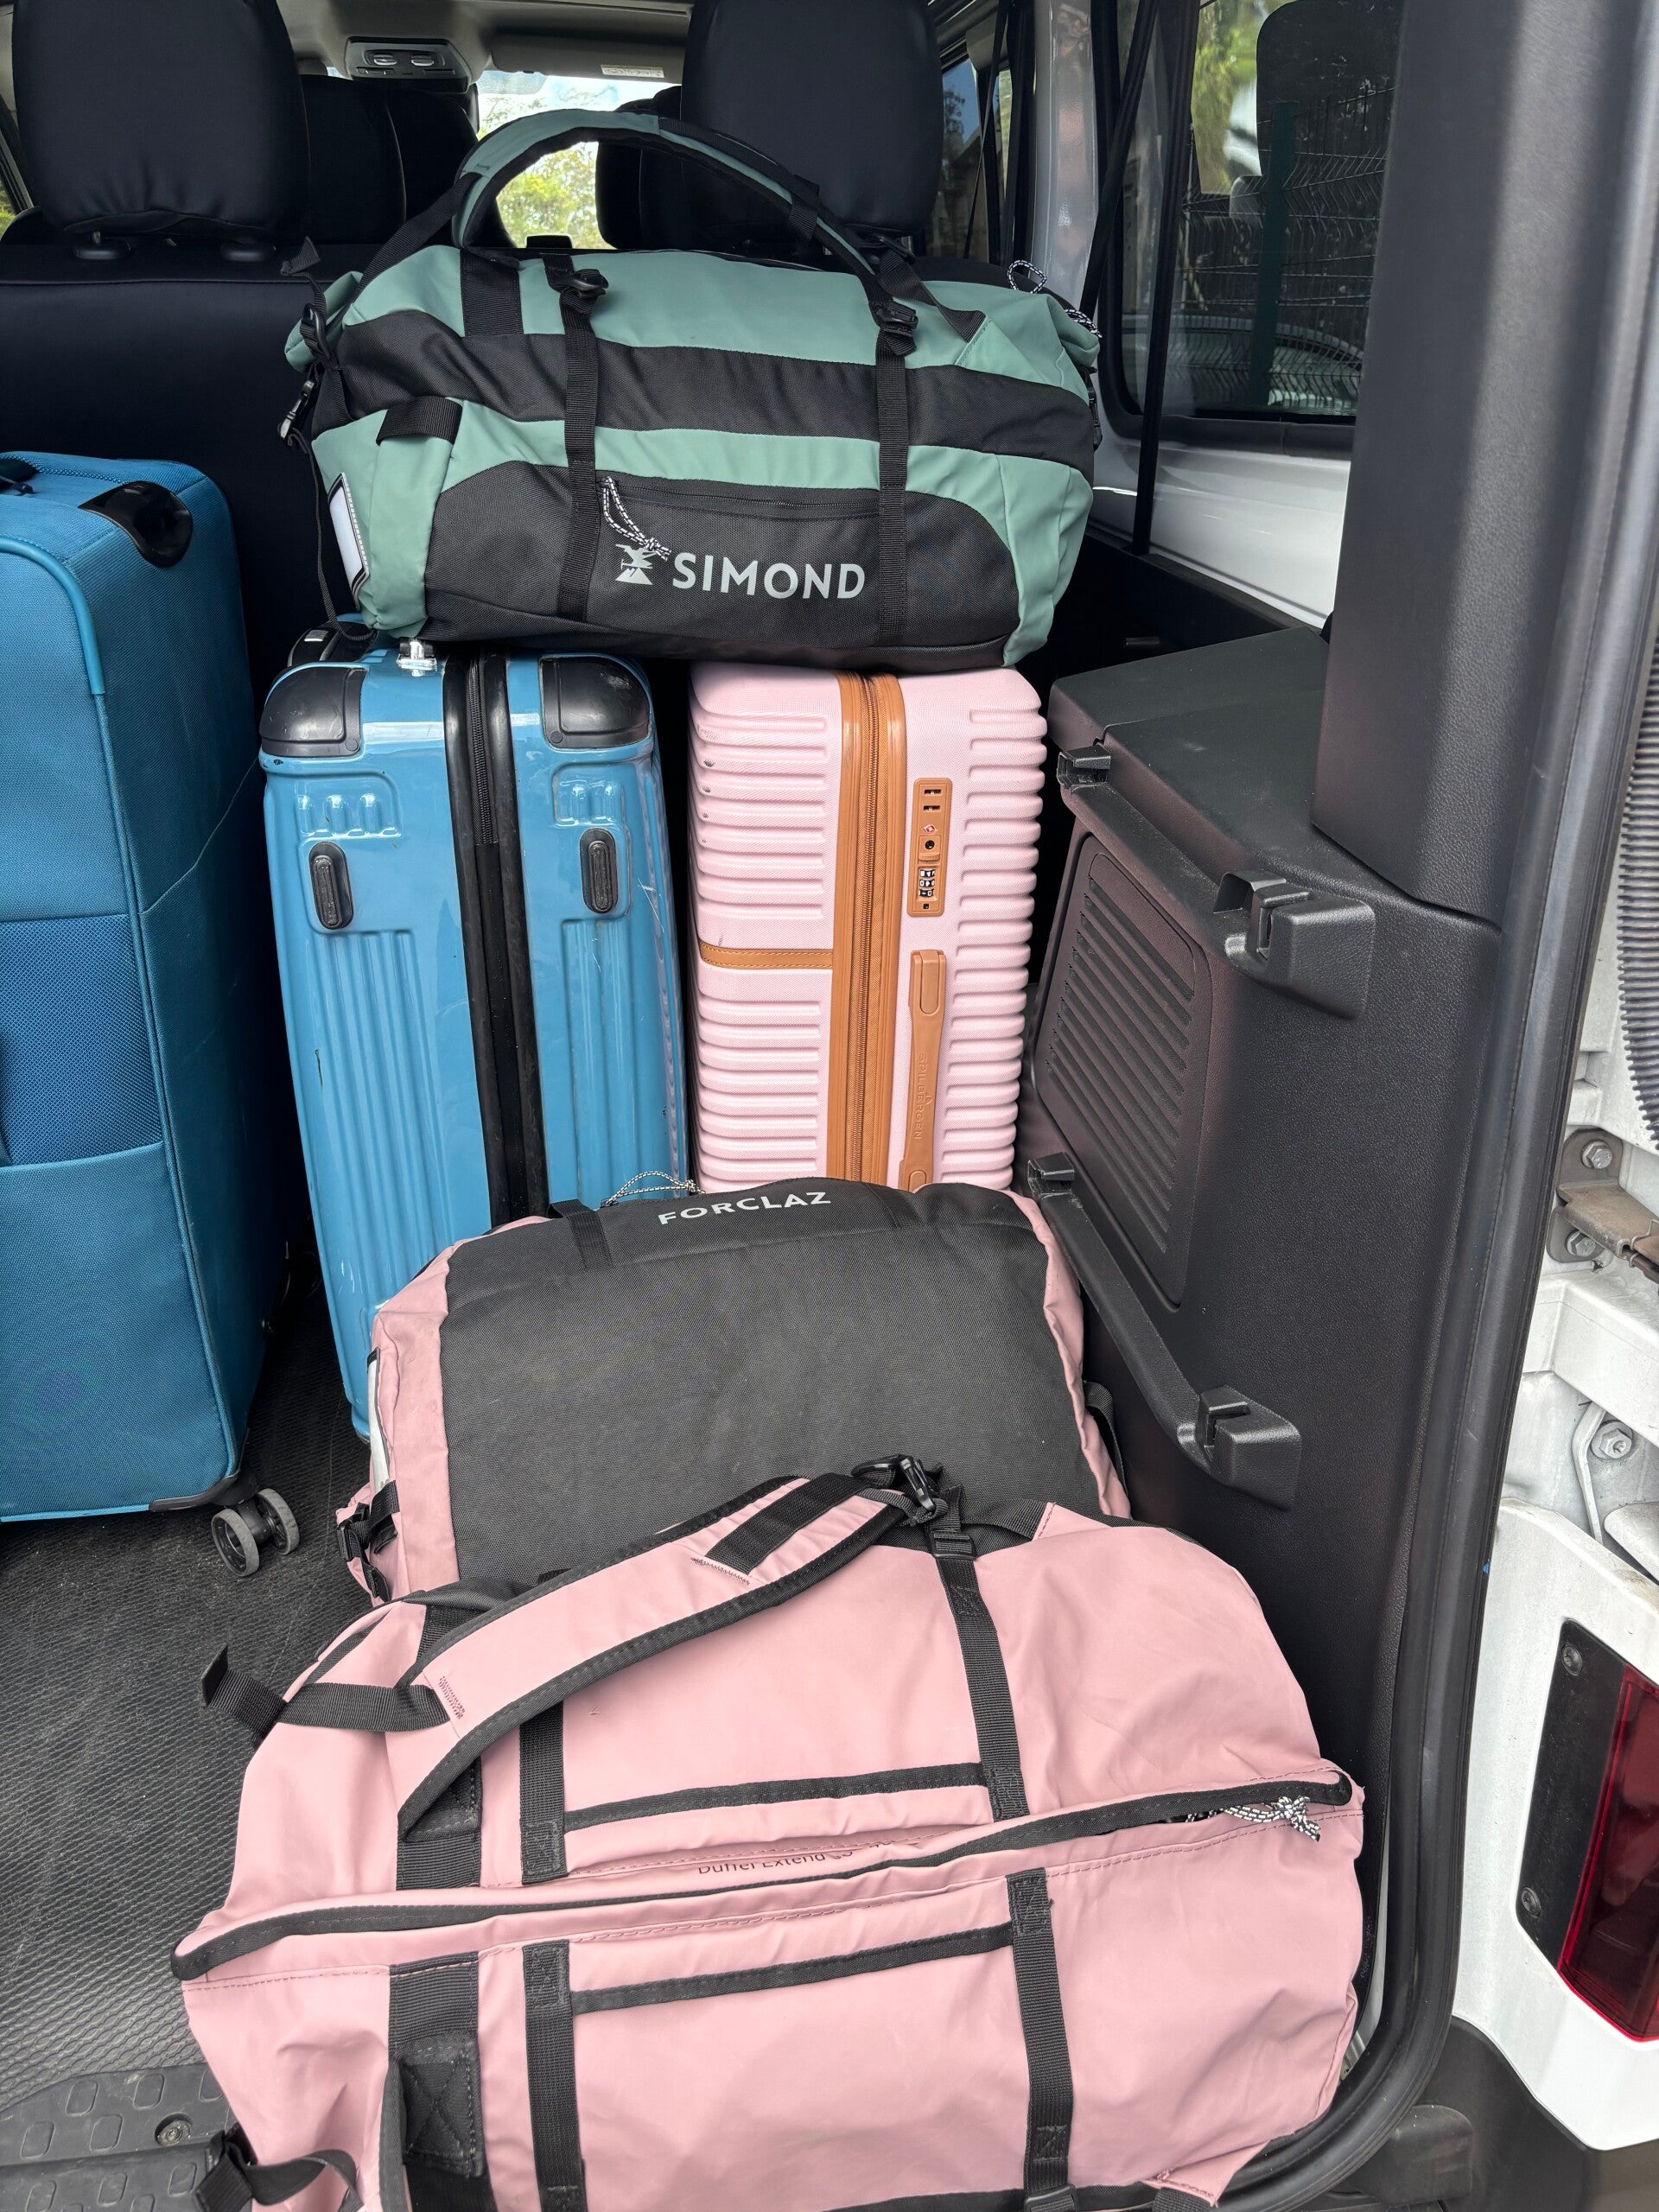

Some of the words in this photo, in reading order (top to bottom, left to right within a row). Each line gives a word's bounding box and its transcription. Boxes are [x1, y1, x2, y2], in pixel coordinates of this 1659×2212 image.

[672, 552, 866, 600] SIMOND
[913, 1052, 927, 1141] SPILBERGEN
[658, 1191, 831, 1225] FORCLAZ
